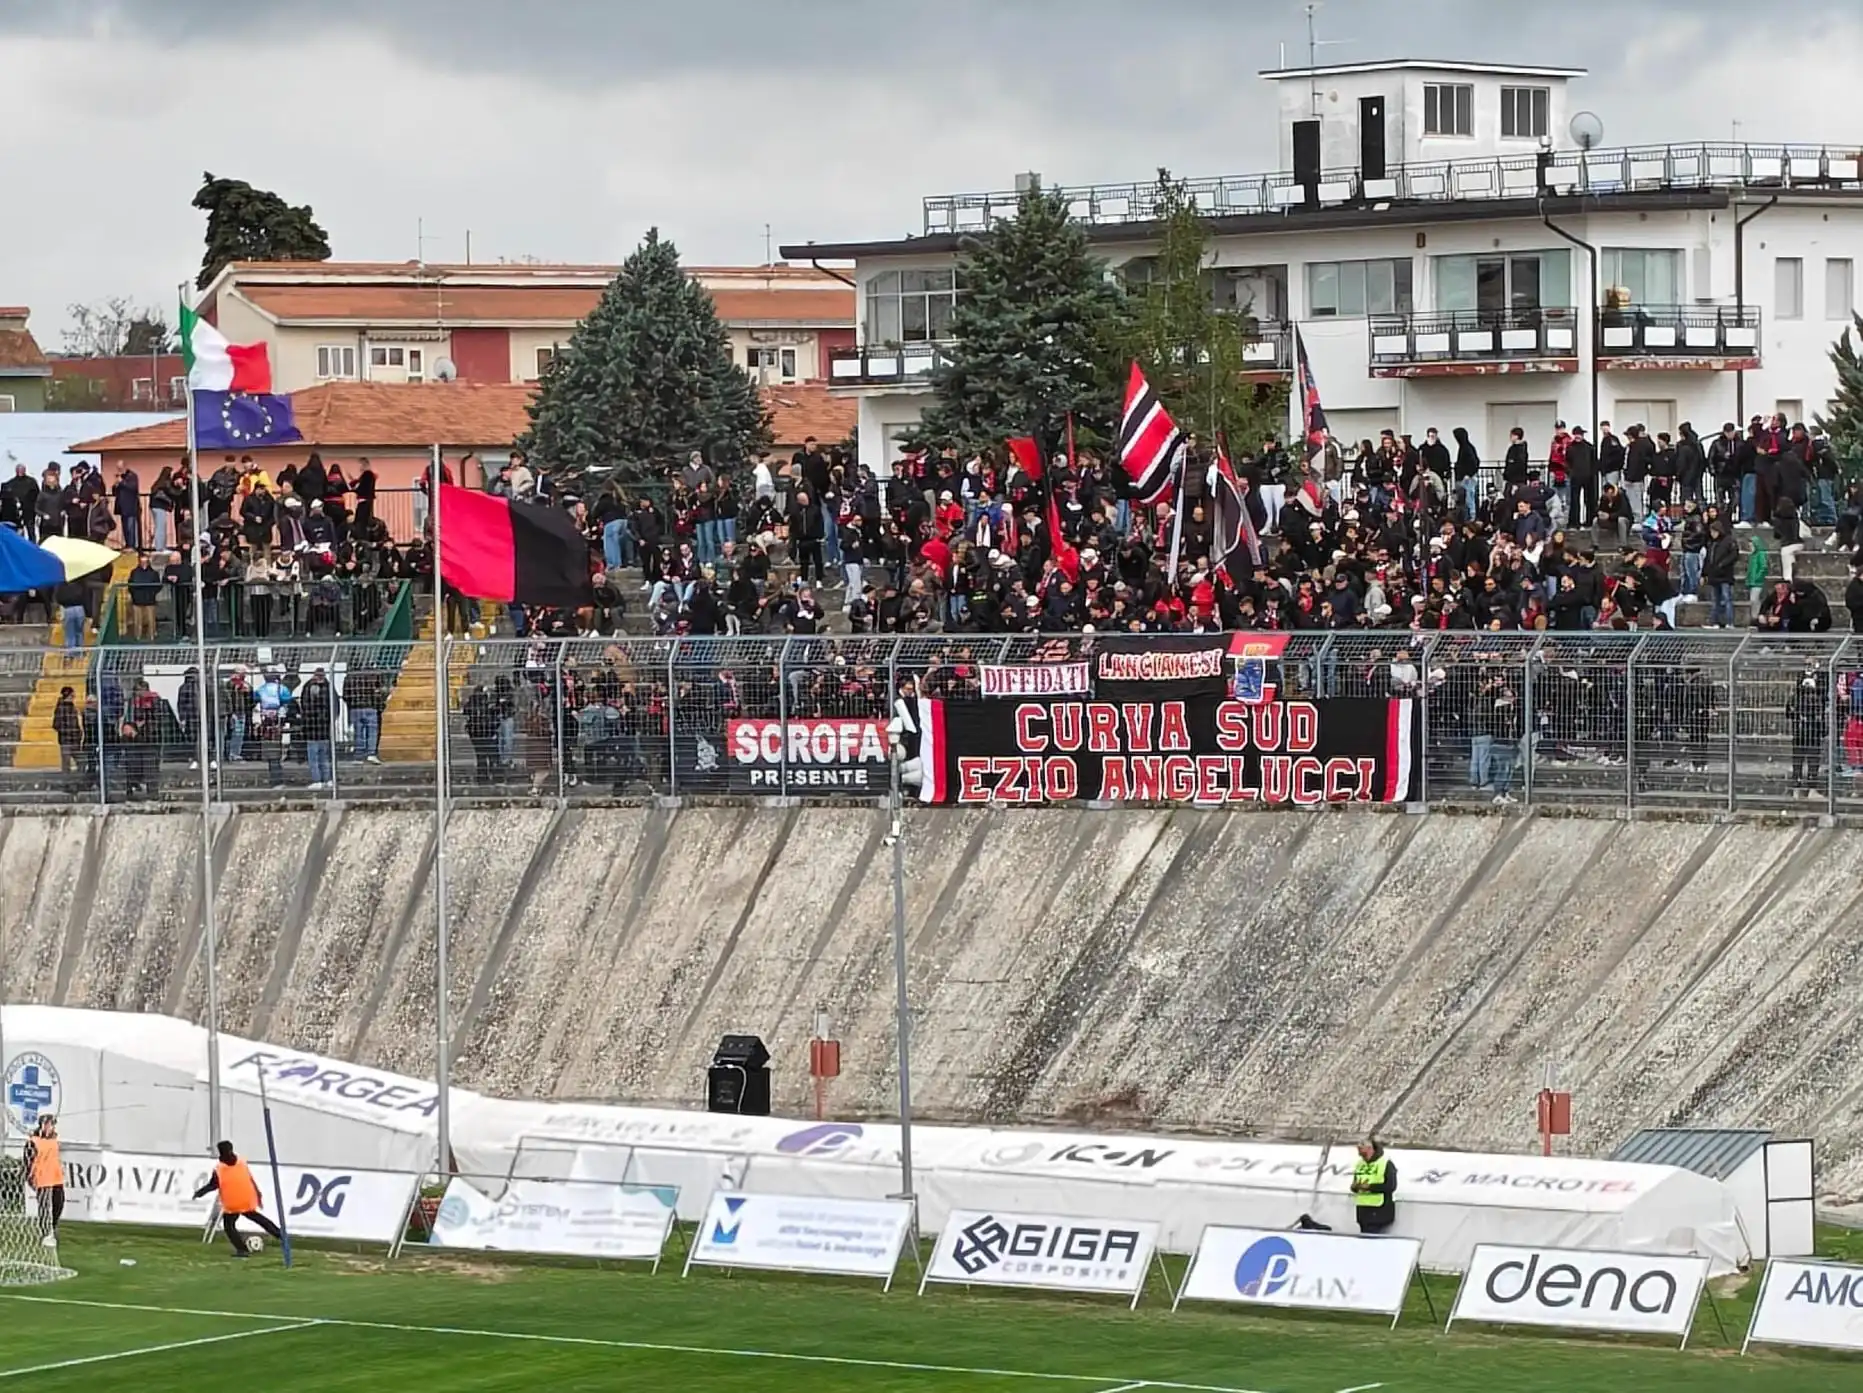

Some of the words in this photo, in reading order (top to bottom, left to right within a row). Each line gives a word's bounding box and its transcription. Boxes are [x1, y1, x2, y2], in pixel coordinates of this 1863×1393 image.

[984, 663, 1087, 694] DIFFIDATI
[734, 723, 886, 765] SCROFA
[1015, 702, 1191, 752] CURVA
[1216, 701, 1320, 752] SUD
[750, 769, 868, 786] PRESENTE
[957, 755, 1079, 804] EZIO
[1097, 755, 1377, 805] ANGELUCCI
[1460, 1173, 1640, 1193] MACROTEL
[1008, 1223, 1140, 1264] GIGA
[1001, 1260, 1128, 1281] COMPOSITE
[1485, 1253, 1678, 1315] dena
